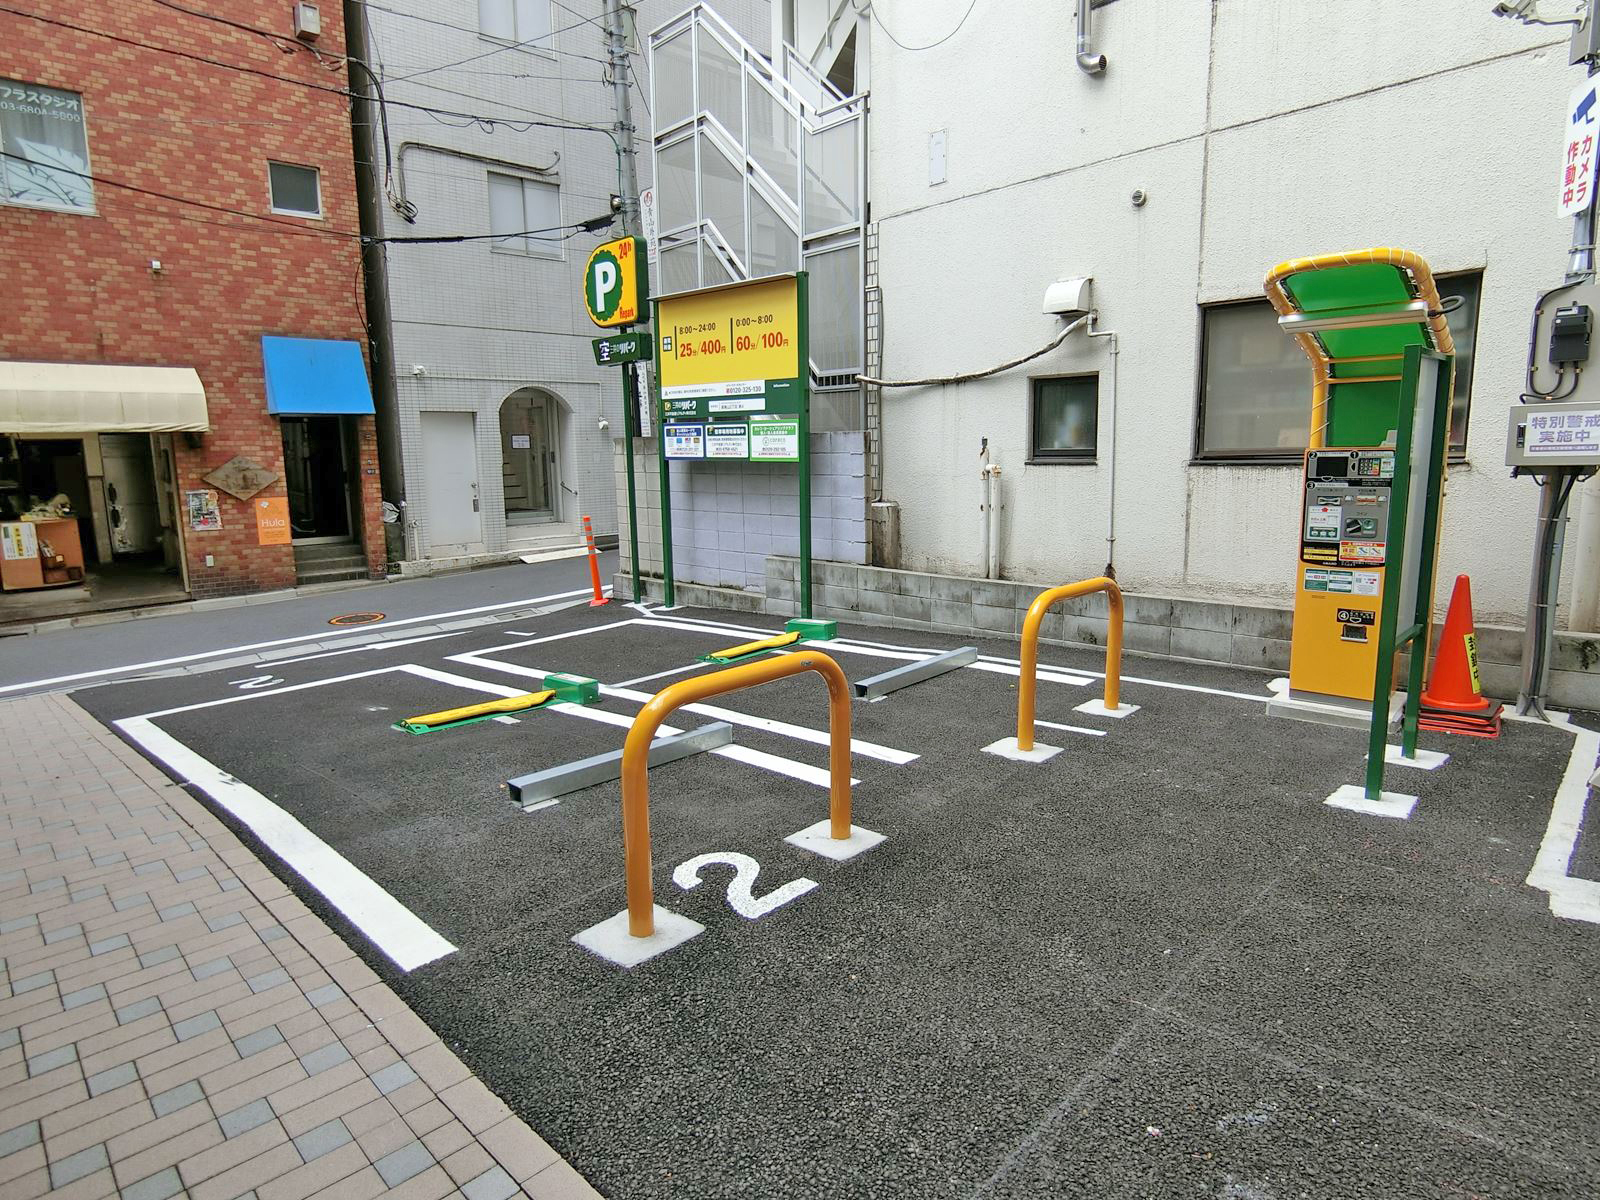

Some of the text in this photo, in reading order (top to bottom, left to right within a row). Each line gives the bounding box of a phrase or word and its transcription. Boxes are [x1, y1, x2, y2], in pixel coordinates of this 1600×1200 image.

[1562, 142, 1580, 208] 作動中
[1576, 135, 1593, 203] カメラ
[619, 241, 632, 260] 24h
[594, 261, 617, 313] P
[619, 306, 634, 320] Repark
[598, 341, 611, 361] 空
[1538, 429, 1591, 443] 実施中
[261, 519, 285, 527] Hula
[672, 851, 820, 919] 2
